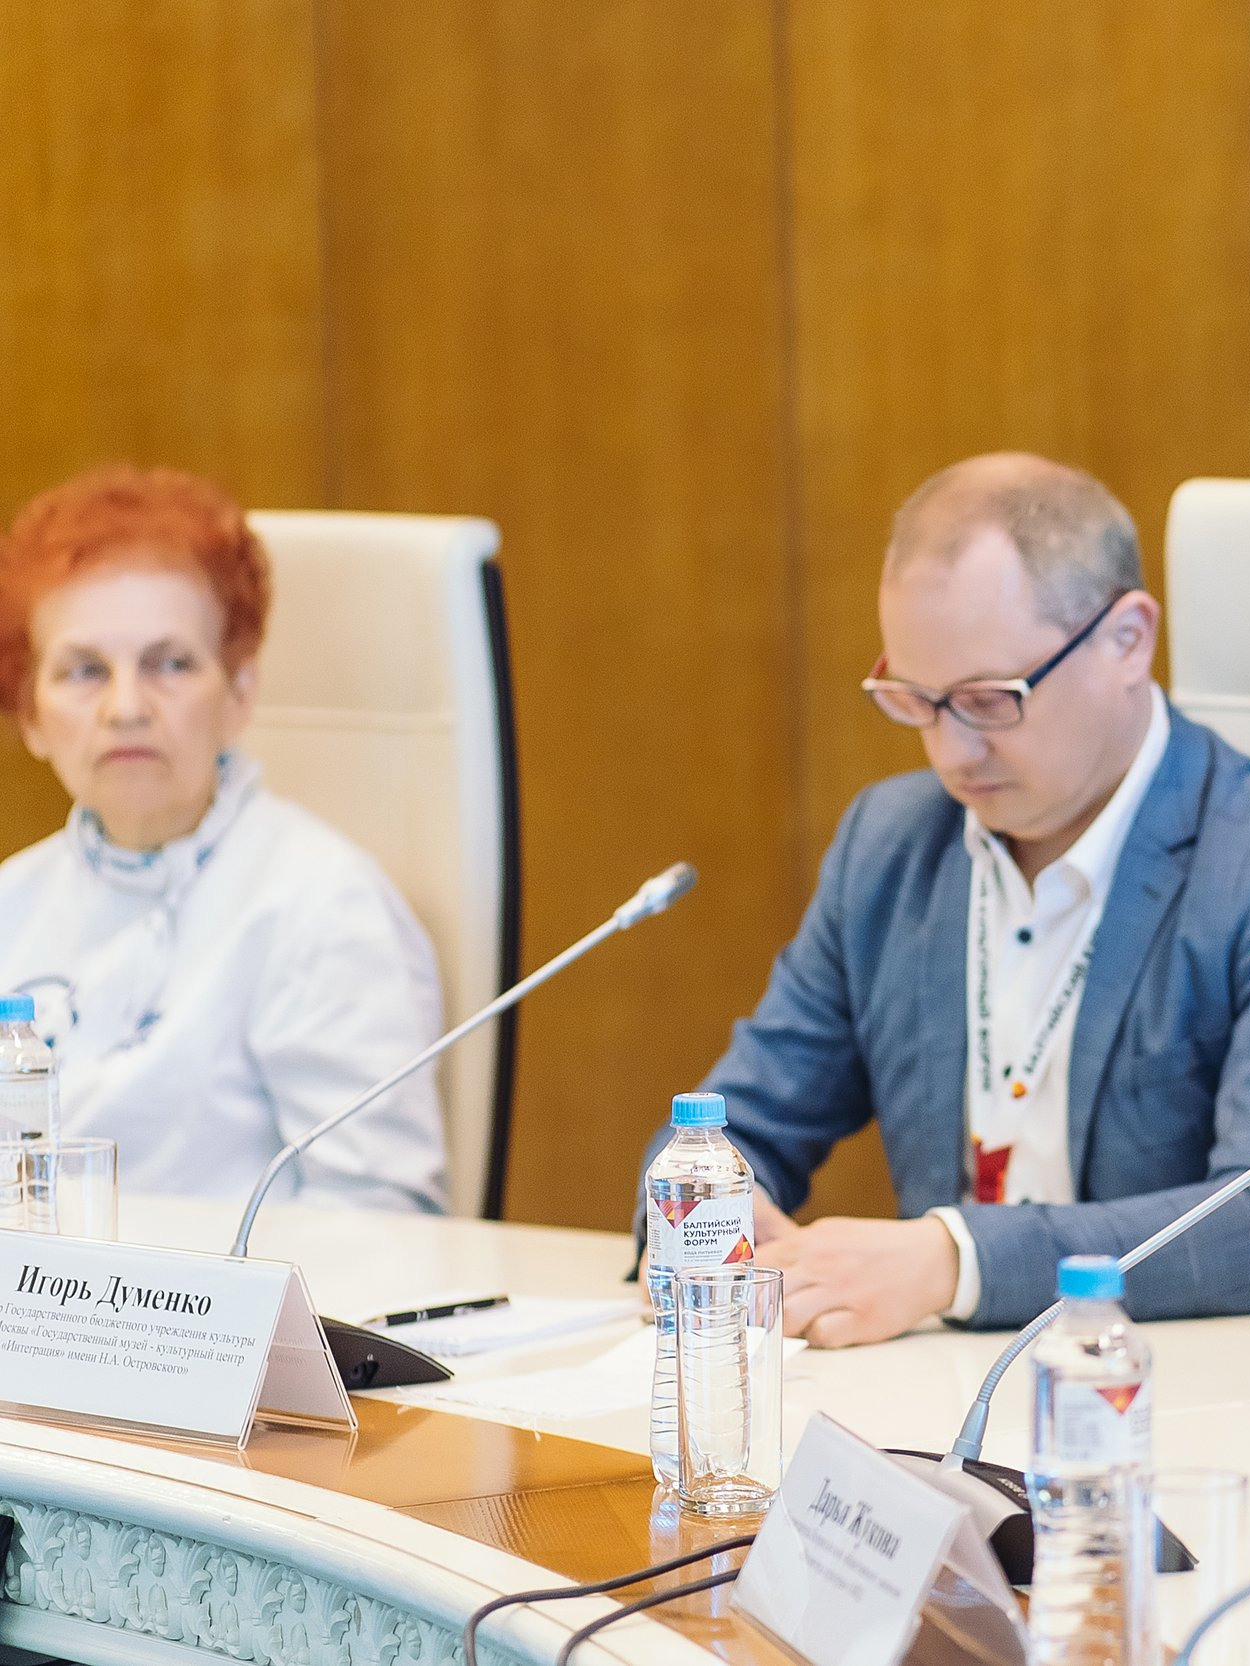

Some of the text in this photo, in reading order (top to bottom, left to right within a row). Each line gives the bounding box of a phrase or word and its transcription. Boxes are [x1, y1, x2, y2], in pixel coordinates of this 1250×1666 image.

[683, 1216, 742, 1230] БАЛТИЙСКИЙ
[683, 1226, 741, 1238] КУЛЬТУРНЫЙ
[683, 1238, 718, 1247] ФОРУМ
[15, 1265, 212, 1317] Игорь Думенко
[0, 1319, 30, 1336] осквы
[31, 1325, 118, 1348] «Государственный
[118, 1339, 148, 1352] музей
[156, 1343, 214, 1361] культурный
[216, 1352, 245, 1367] центр
[5, 1302, 88, 1324] Государственного
[89, 1314, 148, 1332] бюджетного
[148, 1323, 208, 1341] учреждения
[208, 1332, 257, 1348] культуры
[1, 1339, 189, 1376] «Интеграция» имени Н.А. Островского»
